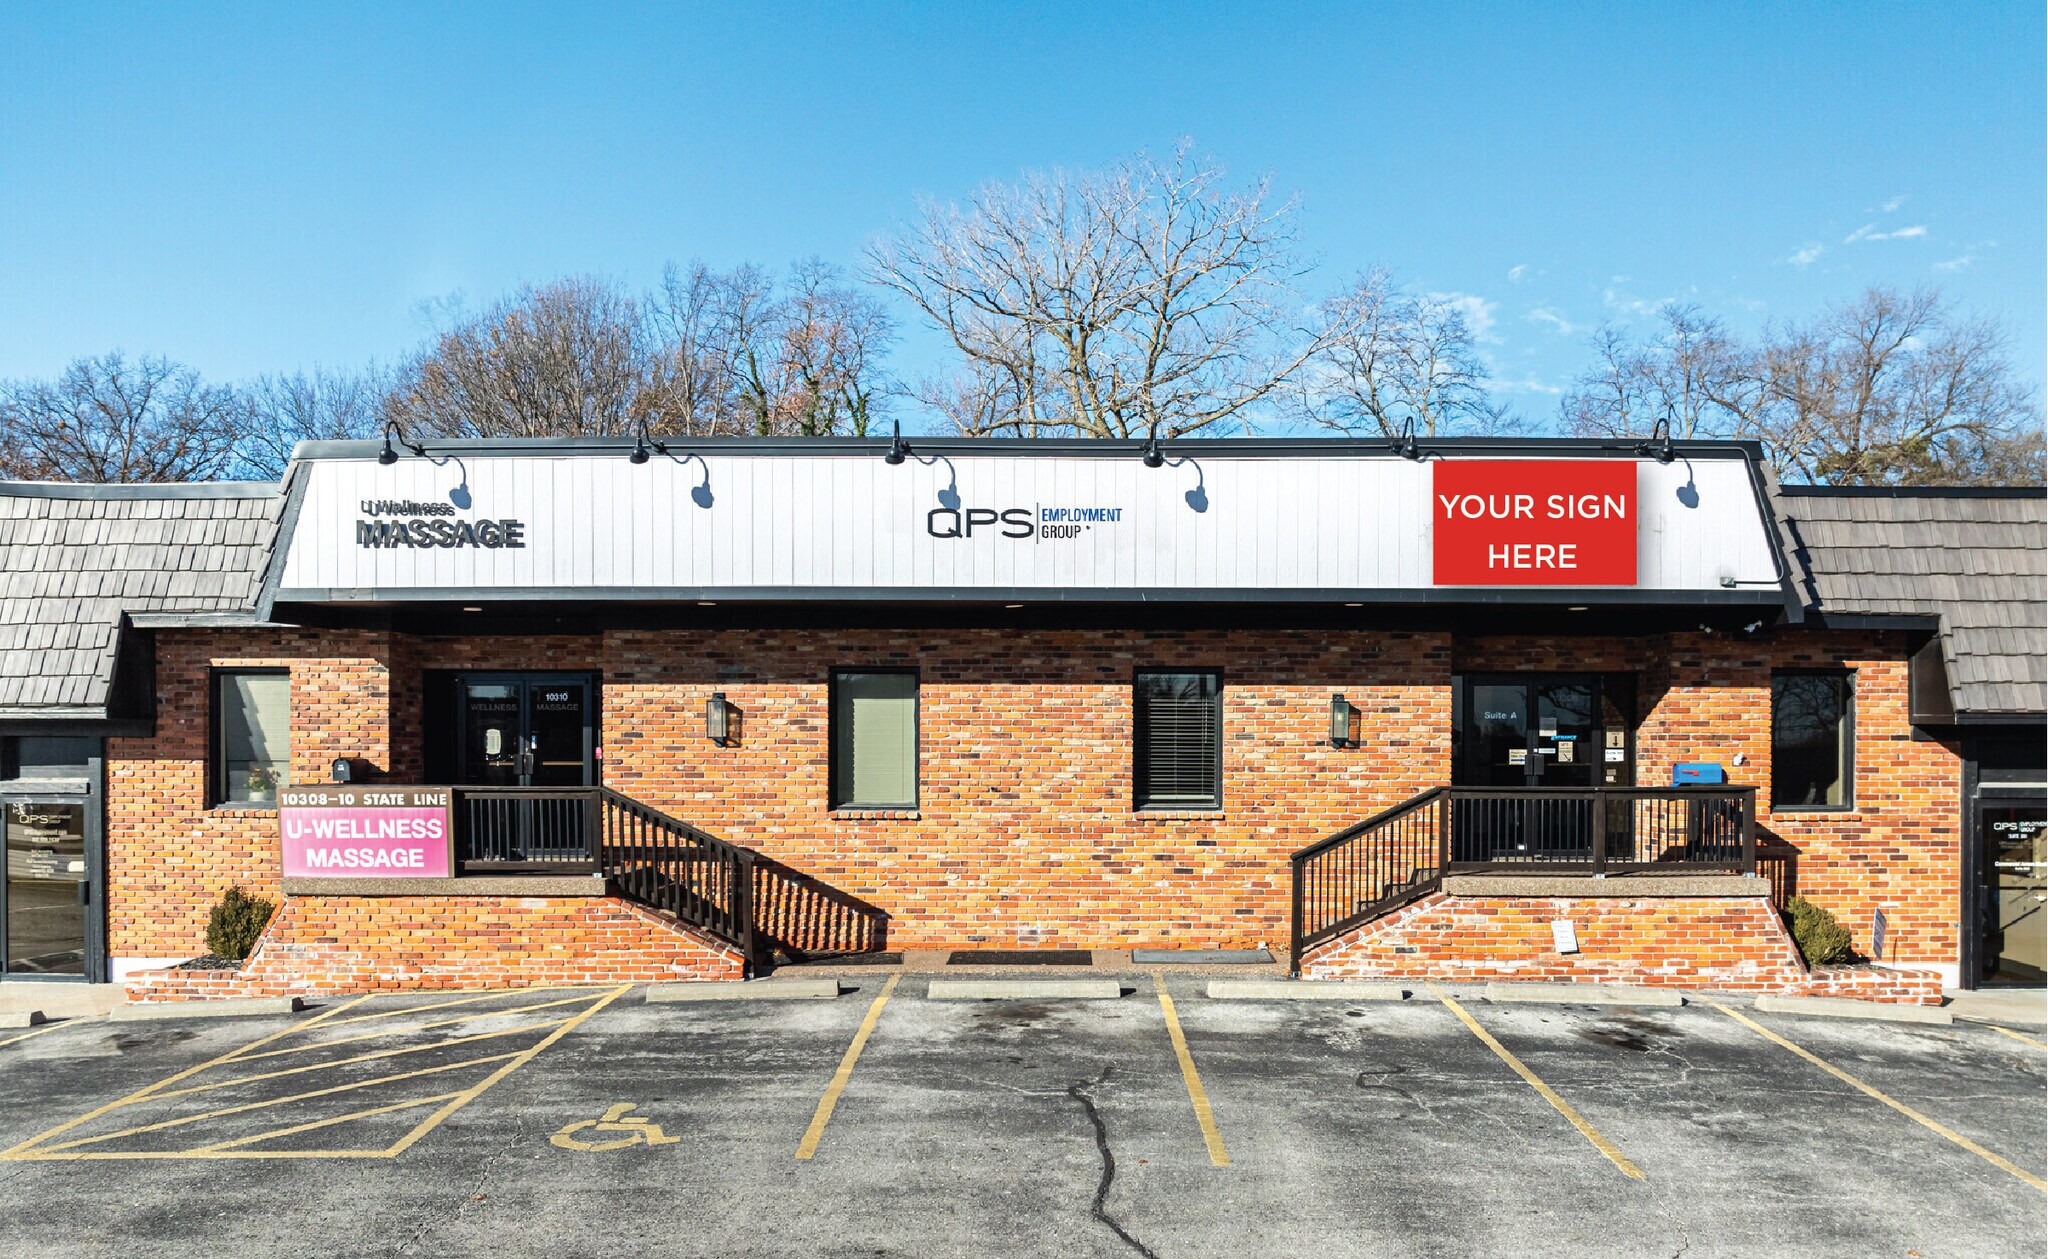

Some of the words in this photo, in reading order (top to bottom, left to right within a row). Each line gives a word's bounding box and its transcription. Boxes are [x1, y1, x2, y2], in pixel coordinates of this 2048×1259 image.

[377, 500, 453, 515] Wellness
[1041, 508, 1123, 522] EMPLOYMENT
[927, 508, 1035, 539] QPS
[356, 519, 521, 547] MASSAGE
[1041, 525, 1081, 539] GROUP
[545, 692, 568, 702] 10310
[470, 703, 517, 711] WELLNESS
[536, 703, 578, 711] MASSAGE
[1484, 711, 1508, 720] Suite
[282, 793, 356, 806] 10308-10
[363, 793, 405, 806] STATE
[413, 793, 447, 806] LINE
[19, 814, 48, 824] QPS
[286, 818, 443, 839] U-WELLNESS
[1993, 822, 2018, 830] QPS
[306, 848, 425, 868] MASSAGE
